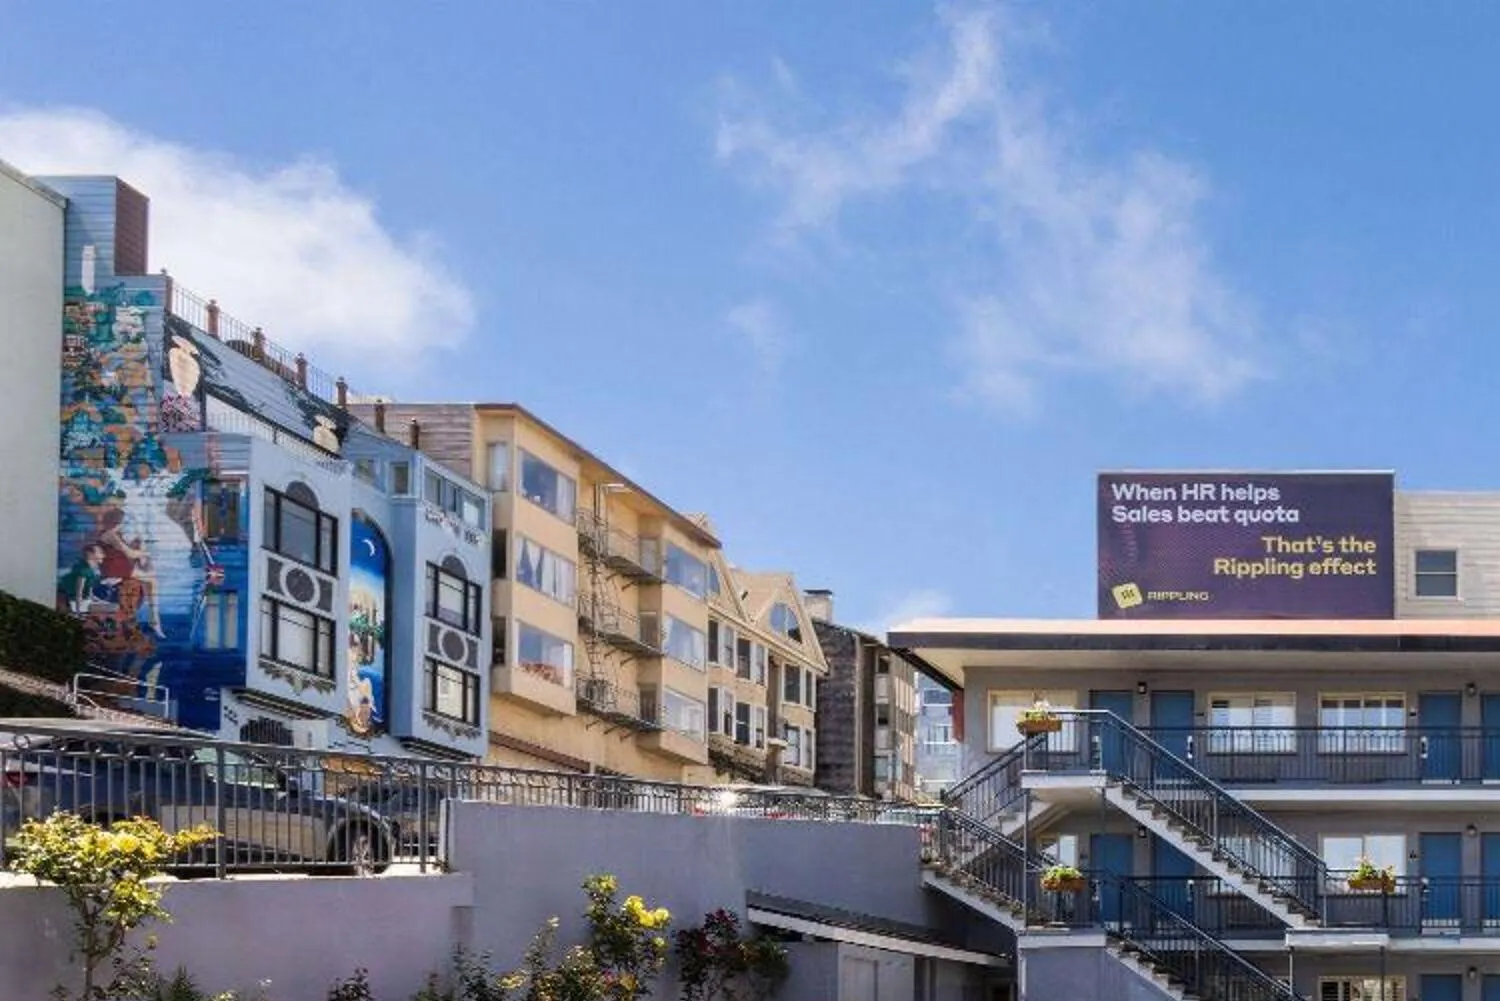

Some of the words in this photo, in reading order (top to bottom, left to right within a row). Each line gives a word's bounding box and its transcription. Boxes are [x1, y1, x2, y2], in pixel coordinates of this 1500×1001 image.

[1112, 483, 1177, 501] When
[1182, 484, 1216, 501] HR
[1221, 483, 1280, 505] helps
[1112, 505, 1173, 523] Sales
[1177, 506, 1229, 523] beat
[1234, 506, 1300, 526] quota
[1261, 536, 1335, 554] That's
[1339, 536, 1377, 554] the
[1213, 558, 1304, 579] Rippling
[1309, 558, 1377, 576] effect
